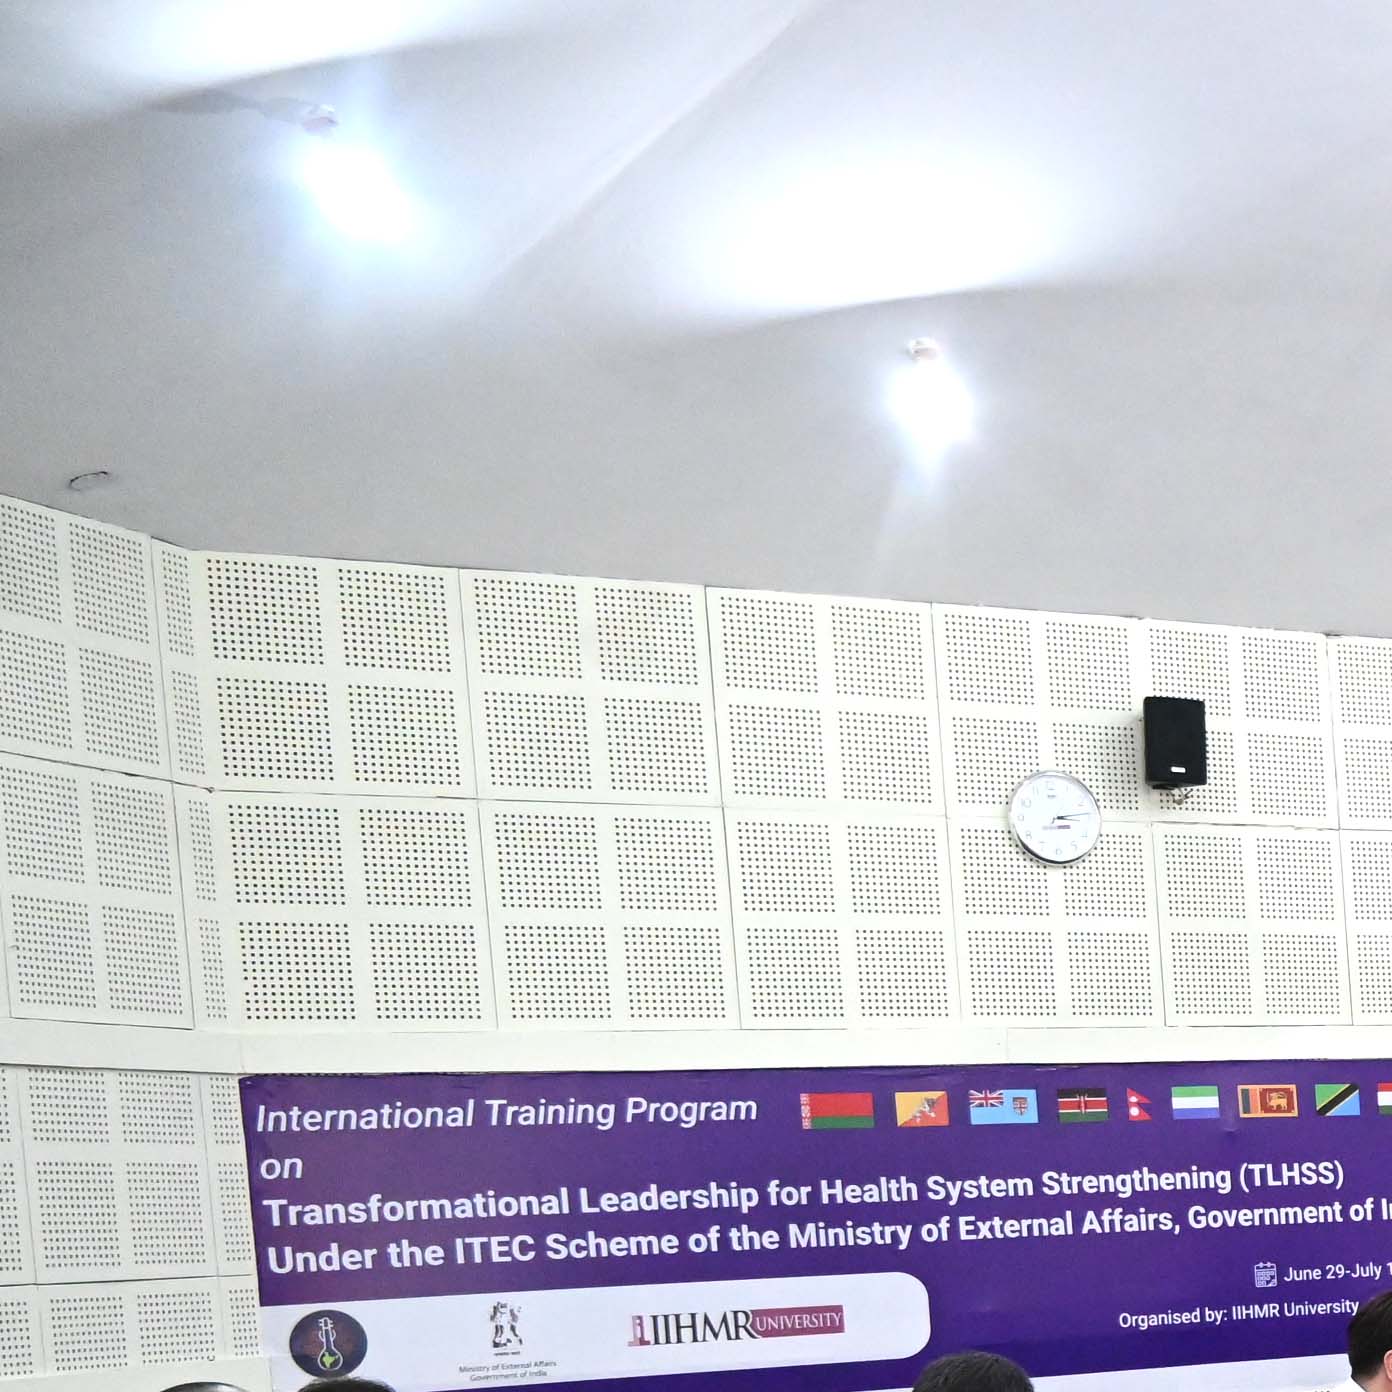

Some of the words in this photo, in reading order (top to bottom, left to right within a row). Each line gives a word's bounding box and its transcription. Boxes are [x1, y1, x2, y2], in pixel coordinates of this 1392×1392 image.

[257, 1099, 474, 1132] International
[485, 1098, 615, 1130] Training
[627, 1097, 757, 1128] Program
[260, 1157, 303, 1180] on
[262, 1187, 569, 1227] Transformational
[580, 1181, 758, 1214] Leadership
[767, 1180, 811, 1206] for
[821, 1176, 918, 1204] Health
[927, 1176, 1033, 1206] System
[1042, 1166, 1231, 1199] Strengthening
[1239, 1160, 1344, 1193] (TLHSS)
[268, 1242, 377, 1274] Under
[387, 1239, 444, 1268] the
[456, 1235, 535, 1265] ITEC
[546, 1231, 679, 1260] Scheme
[689, 1225, 720, 1253] of
[729, 1224, 779, 1251] the
[789, 1217, 912, 1250] Ministry
[921, 1216, 950, 1243] of
[959, 1211, 1073, 1241] External
[1082, 1208, 1180, 1236] Affairs,
[1188, 1202, 1343, 1229] Government
[1350, 1198, 1374, 1222] of
[1284, 1266, 1322, 1281] June
[1326, 1261, 1382, 1281] 29-July
[650, 1309, 760, 1346] IIHMR
[755, 1312, 843, 1332] UNIVERSITY
[1118, 1307, 1200, 1330] Organised
[1205, 1306, 1229, 1324] by:
[1233, 1303, 1280, 1321] IIHMR
[1285, 1298, 1360, 1320] University
